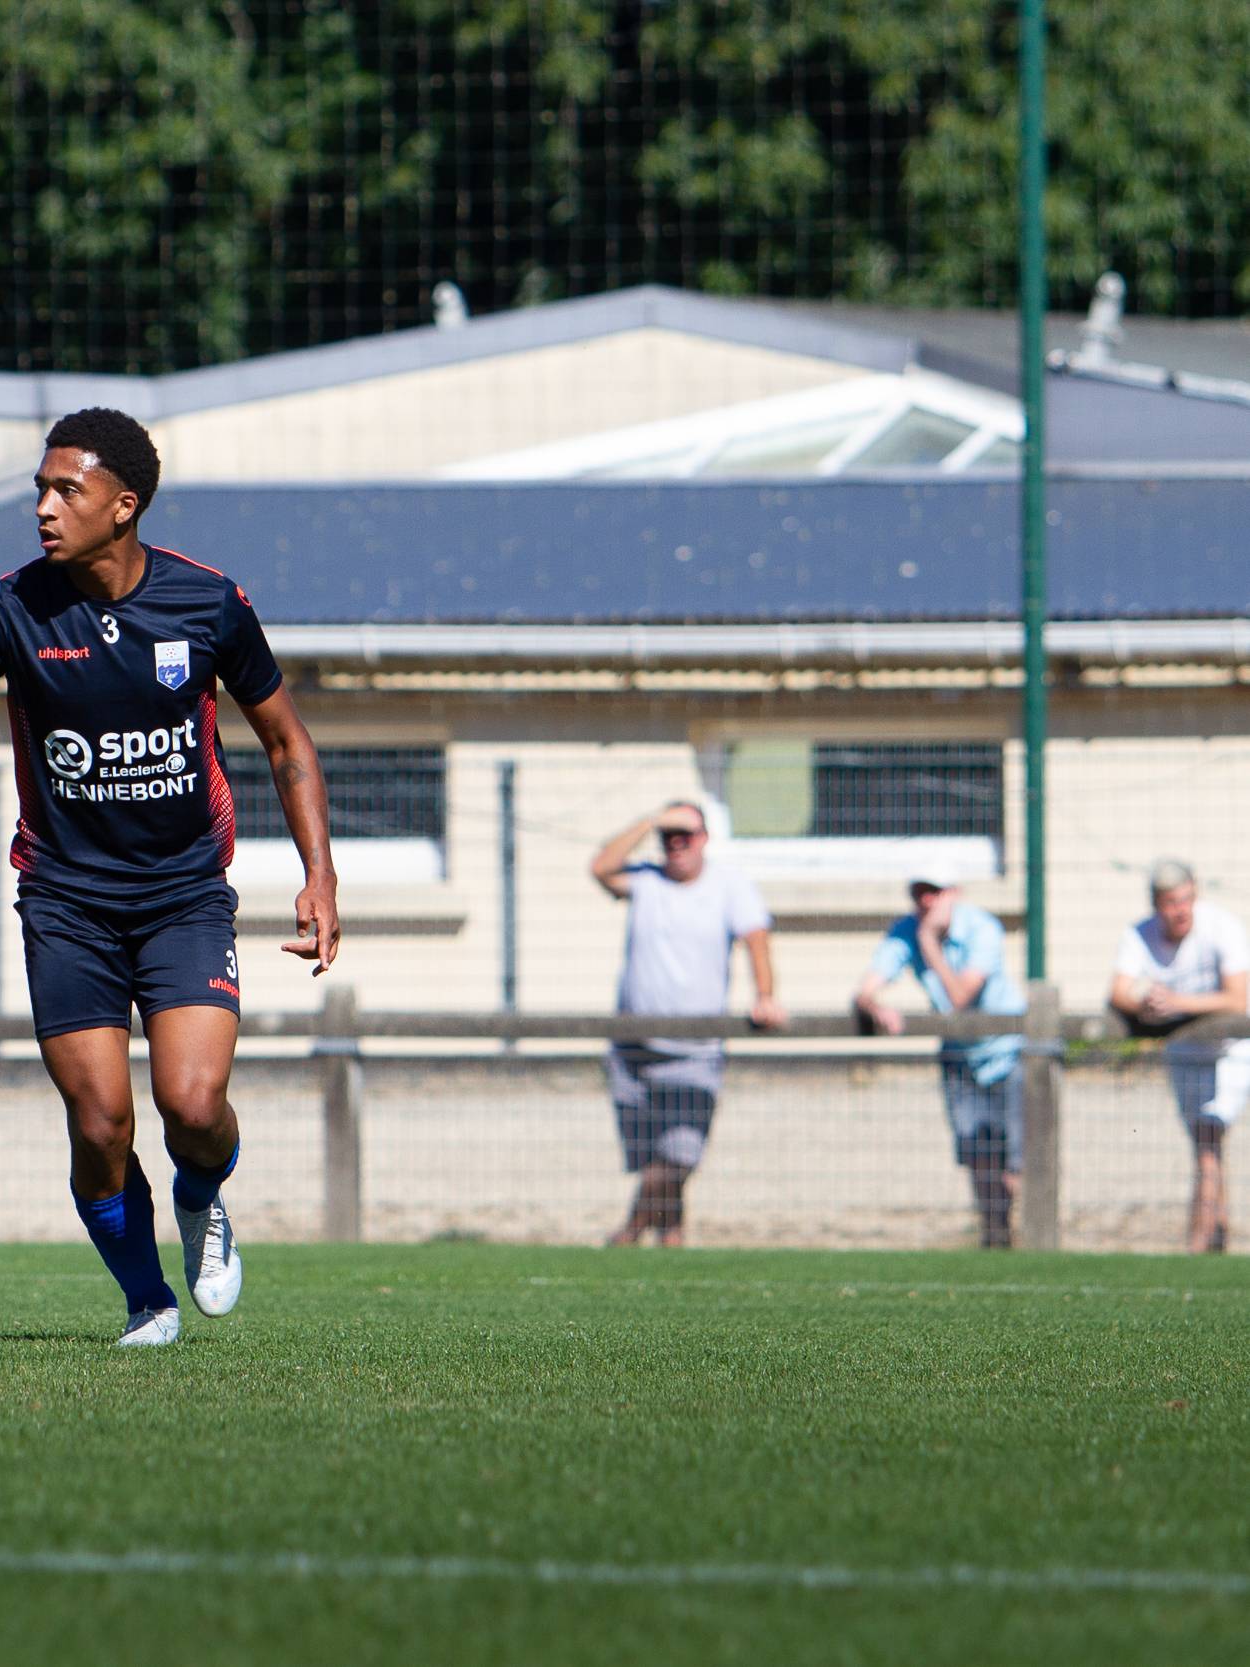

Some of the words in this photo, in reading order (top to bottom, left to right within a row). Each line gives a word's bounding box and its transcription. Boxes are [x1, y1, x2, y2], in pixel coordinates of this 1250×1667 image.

[101, 614, 120, 644] 3
[38, 647, 90, 661] uhlsport
[99, 718, 197, 764] sport
[51, 773, 197, 802] HENNEBONT
[226, 949, 237, 979] 3
